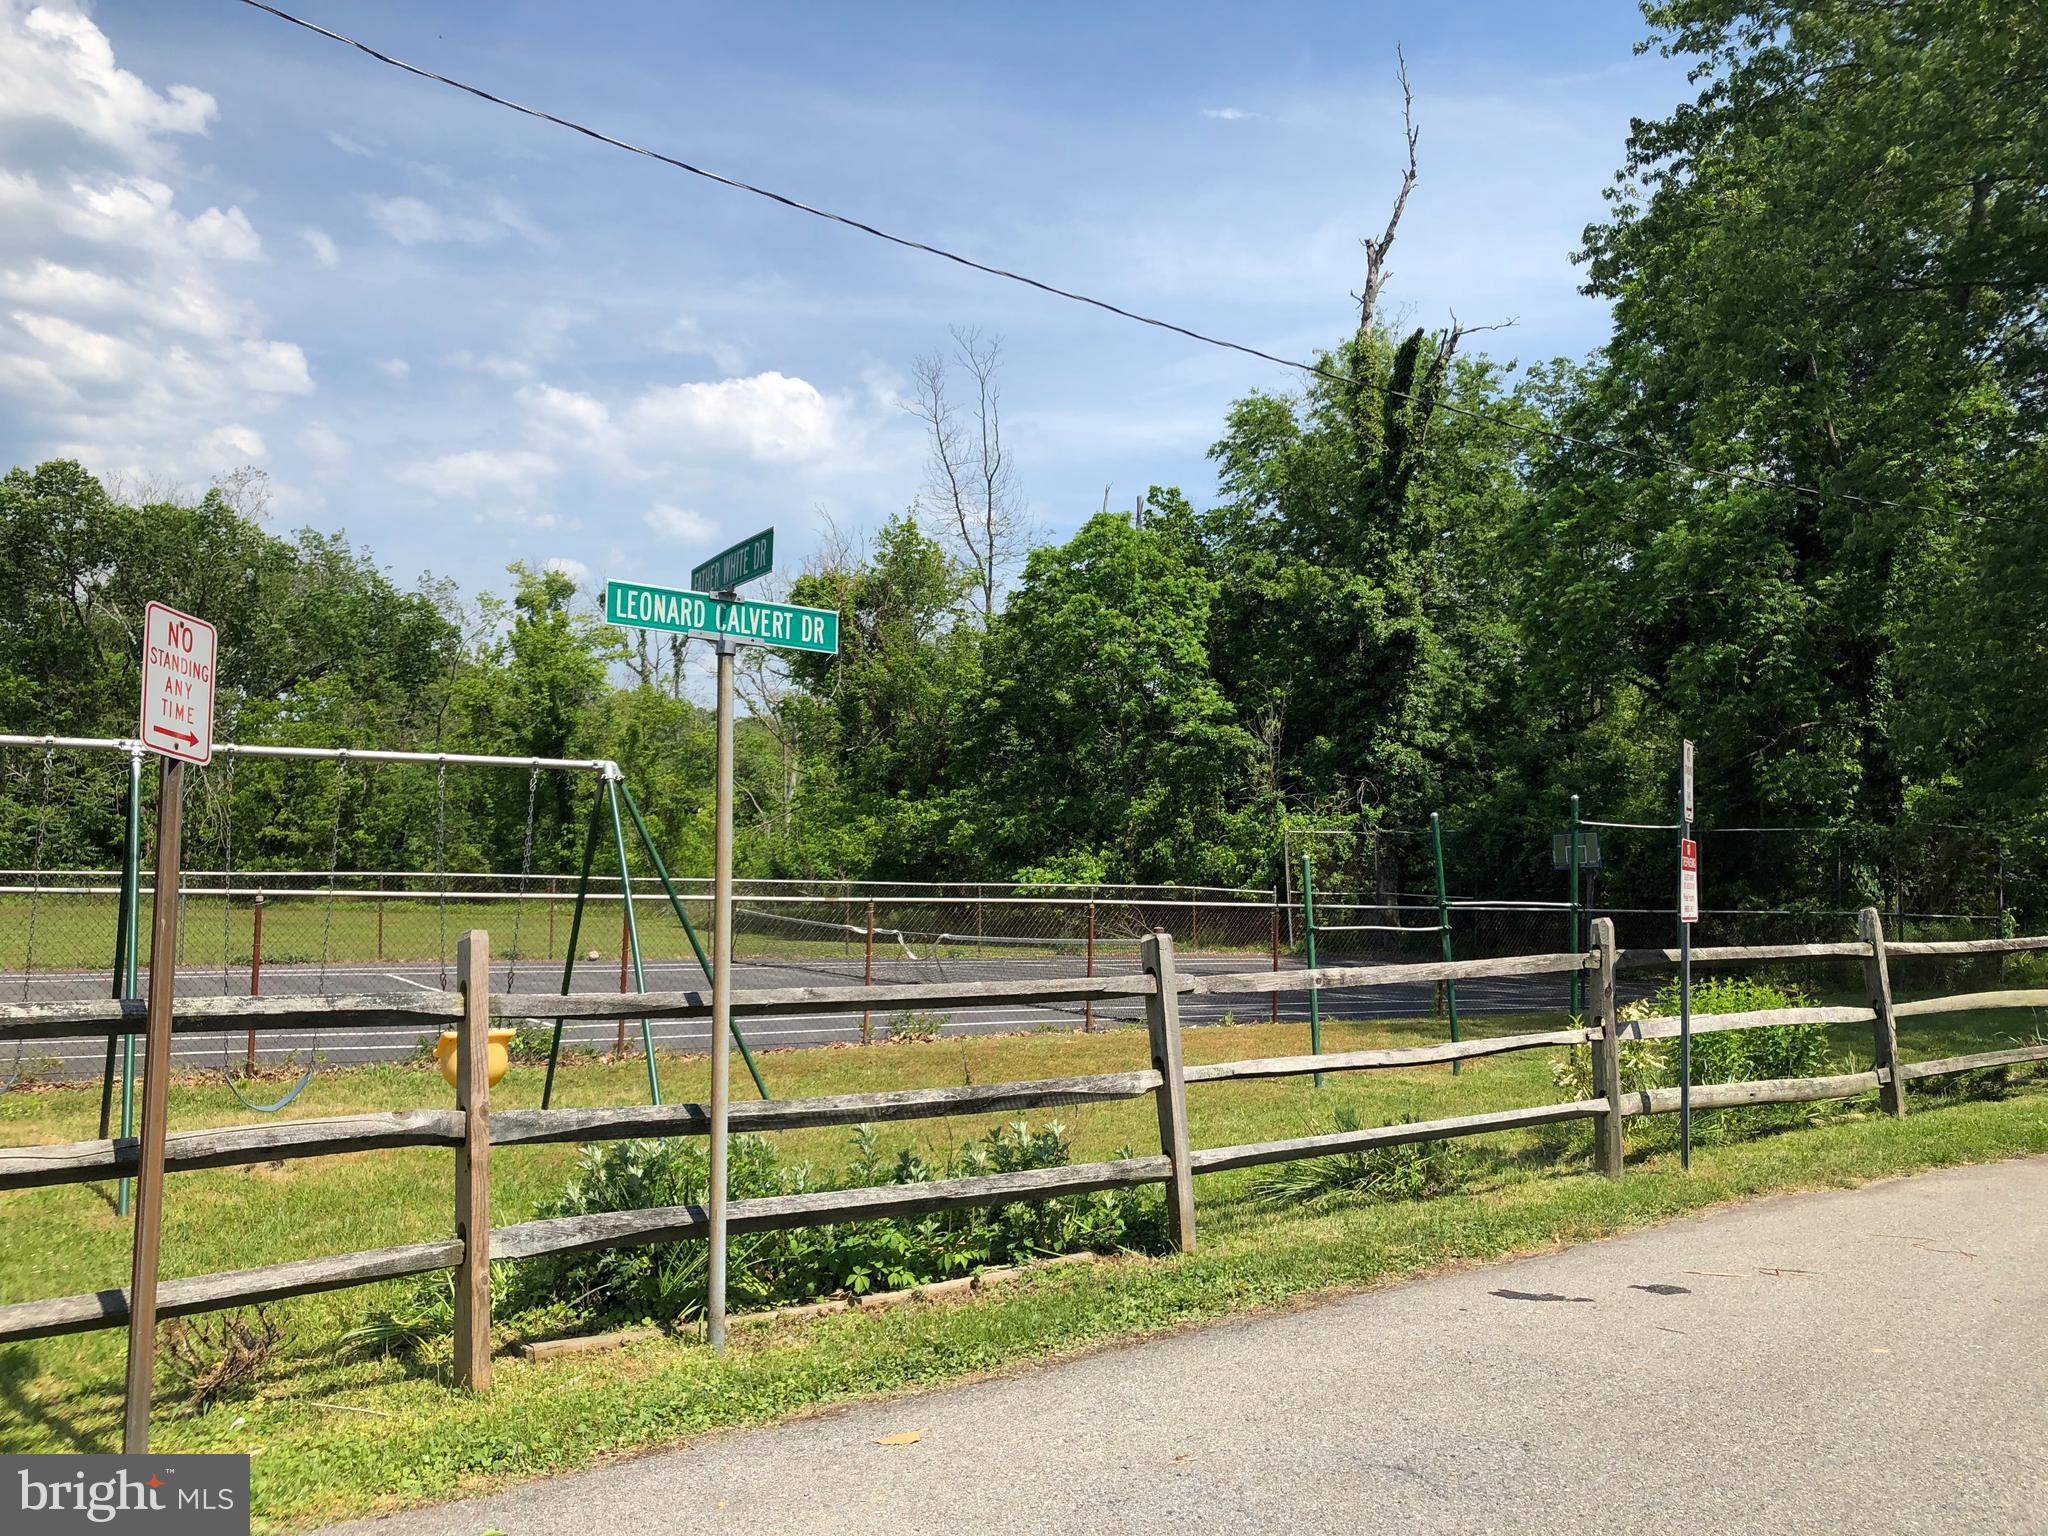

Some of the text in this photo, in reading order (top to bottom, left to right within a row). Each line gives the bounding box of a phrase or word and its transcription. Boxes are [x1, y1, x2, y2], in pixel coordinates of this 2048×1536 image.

[694, 539, 767, 592] FATHER WHITE DR
[616, 588, 825, 644] LEONARD CALVERT DR
[168, 621, 193, 654] NO
[150, 646, 209, 683] STANDING
[165, 676, 193, 700] ANY
[161, 698, 195, 724] TIME
